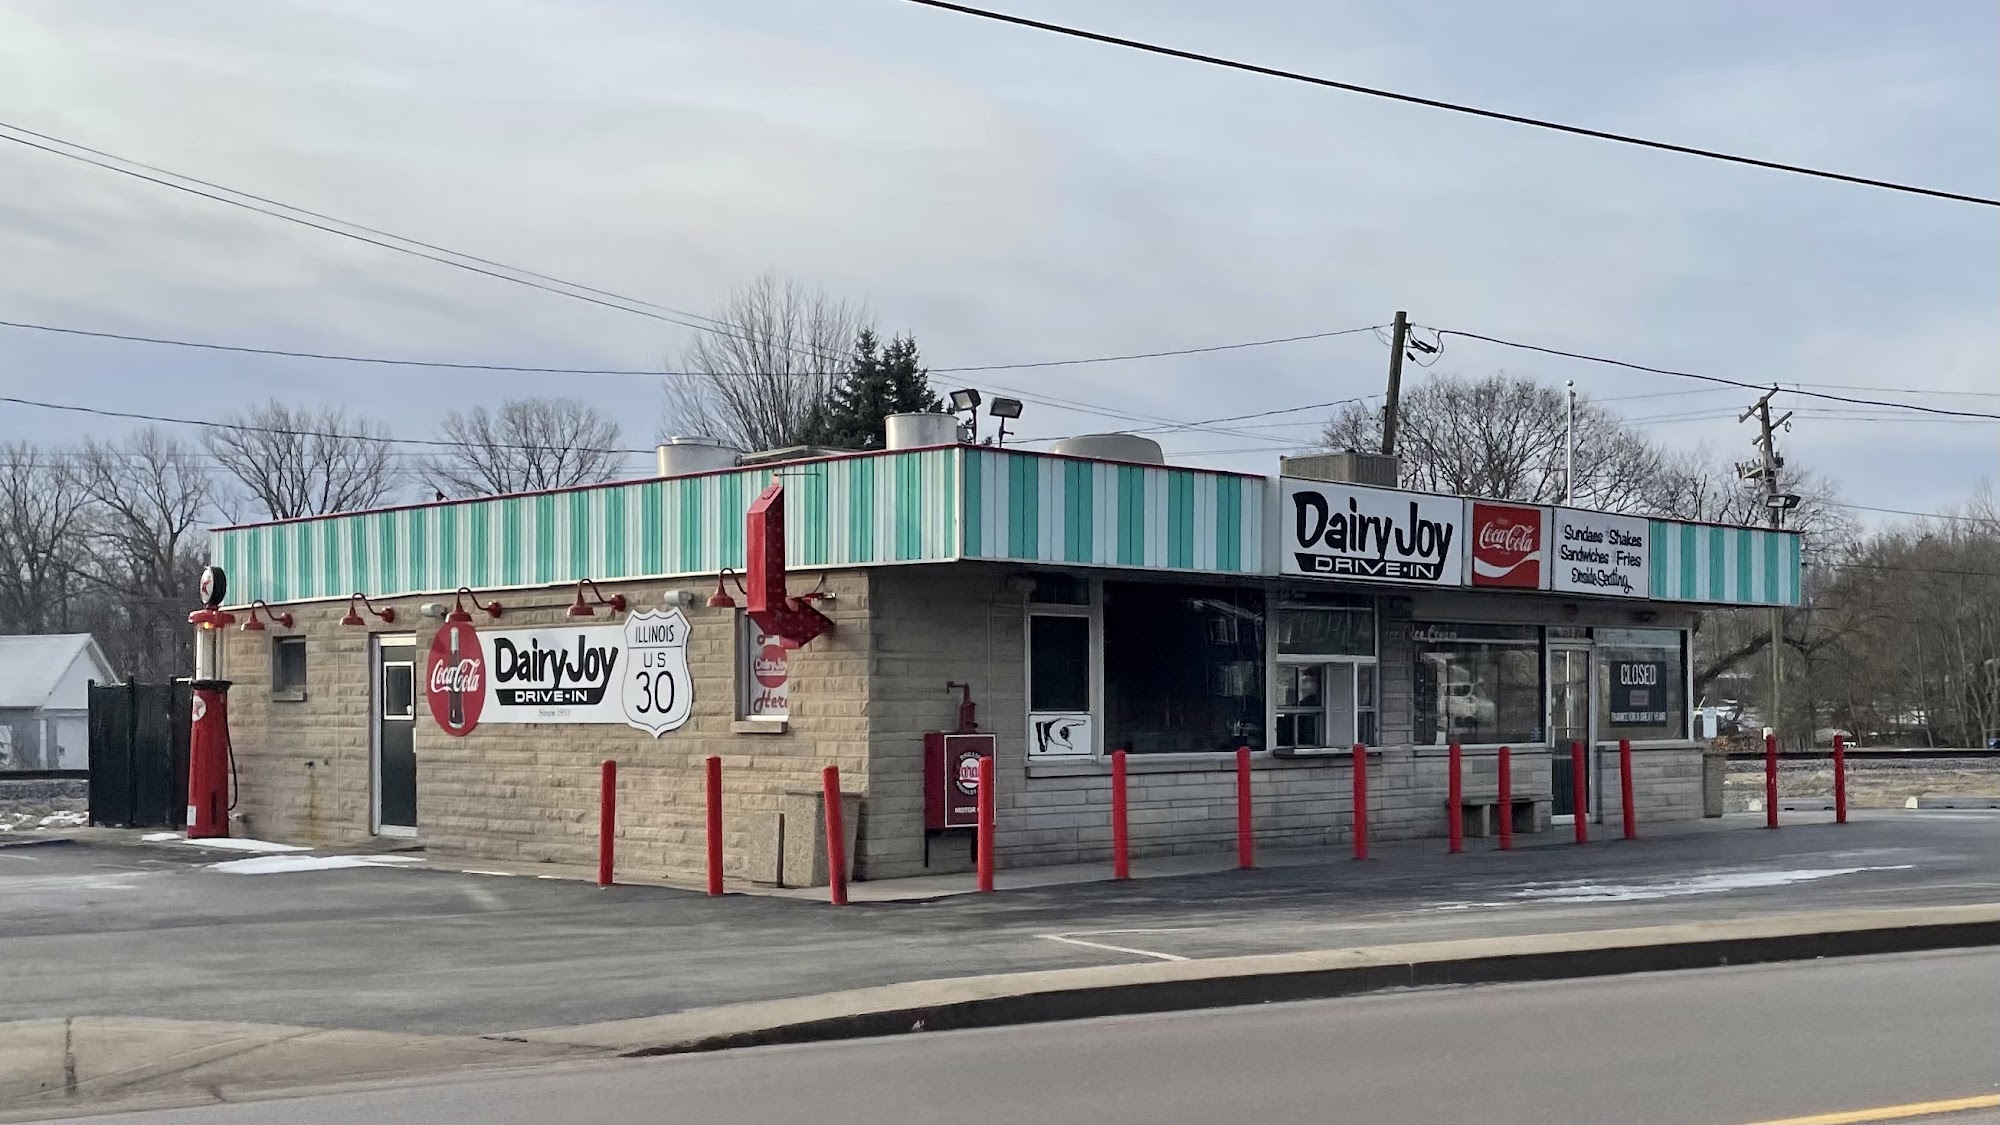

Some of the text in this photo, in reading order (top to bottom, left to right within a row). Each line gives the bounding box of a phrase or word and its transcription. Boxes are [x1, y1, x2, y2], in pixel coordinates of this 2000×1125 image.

[1564, 525, 1642, 547] Sundaes Shakes
[1561, 544, 1642, 567] Sandwiches Fries
[636, 625, 674, 643] ILLINOIS
[643, 652, 666, 668] US
[1621, 664, 1656, 685] CLOSED
[636, 671, 674, 714] 30
[954, 805, 976, 813] MOTOR
